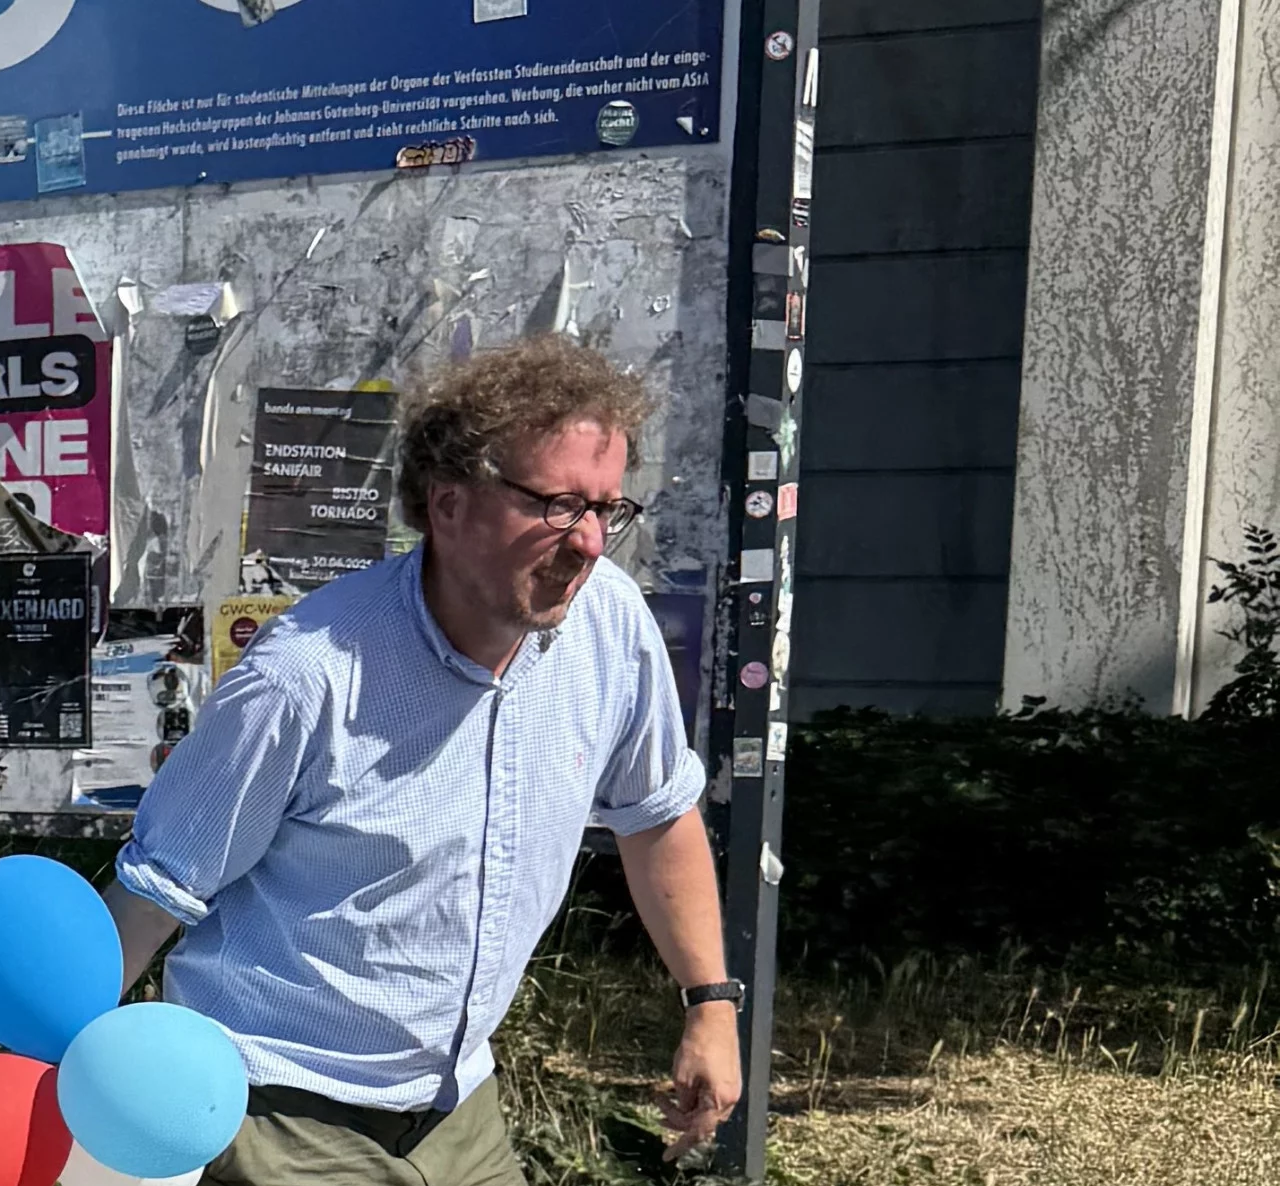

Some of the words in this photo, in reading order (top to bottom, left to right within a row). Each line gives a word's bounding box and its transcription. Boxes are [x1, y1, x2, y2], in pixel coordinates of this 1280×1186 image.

[117, 102, 144, 117] Diese
[147, 99, 179, 115] Fläche
[181, 98, 195, 111] ist
[197, 98, 213, 109] nur
[217, 94, 231, 107] für
[235, 89, 299, 105] studentische
[302, 79, 367, 99] Mitteilungen
[370, 78, 388, 92] der
[391, 75, 430, 93] Organe
[432, 72, 450, 86] der
[454, 67, 512, 84] Verfassten
[514, 54, 623, 79] Studierendenschaft
[626, 53, 648, 68] und
[650, 51, 670, 67] der
[673, 50, 711, 65] einge-
[117, 124, 161, 140] tragenen
[162, 114, 253, 136] Hochschulgruppen
[255, 111, 272, 126] der
[274, 106, 323, 125] Johannes
[324, 94, 441, 119] Gutenberg-Universität
[442, 90, 509, 109] vorgesehen.
[511, 84, 563, 102] Werbung,
[566, 82, 583, 98] die
[586, 78, 622, 95] vorher
[625, 75, 654, 92] nicht
[655, 77, 680, 90] vom
[682, 72, 709, 88] AStA
[116, 144, 169, 164] genehmigt
[171, 141, 204, 157] wurde,
[207, 137, 229, 152] wird
[231, 131, 306, 151] kostenpflichtig
[309, 127, 351, 144] entfernt
[353, 123, 374, 138] und
[377, 122, 403, 138] zieht
[405, 115, 457, 135] rechtliche
[460, 112, 502, 131] Schritte
[505, 110, 530, 127] nach
[534, 107, 559, 124] sich.
[265, 442, 347, 460] ENDSTATION
[263, 462, 323, 478] SANIFAIR
[331, 486, 380, 502] BISTRO
[310, 503, 378, 521] TORNADO
